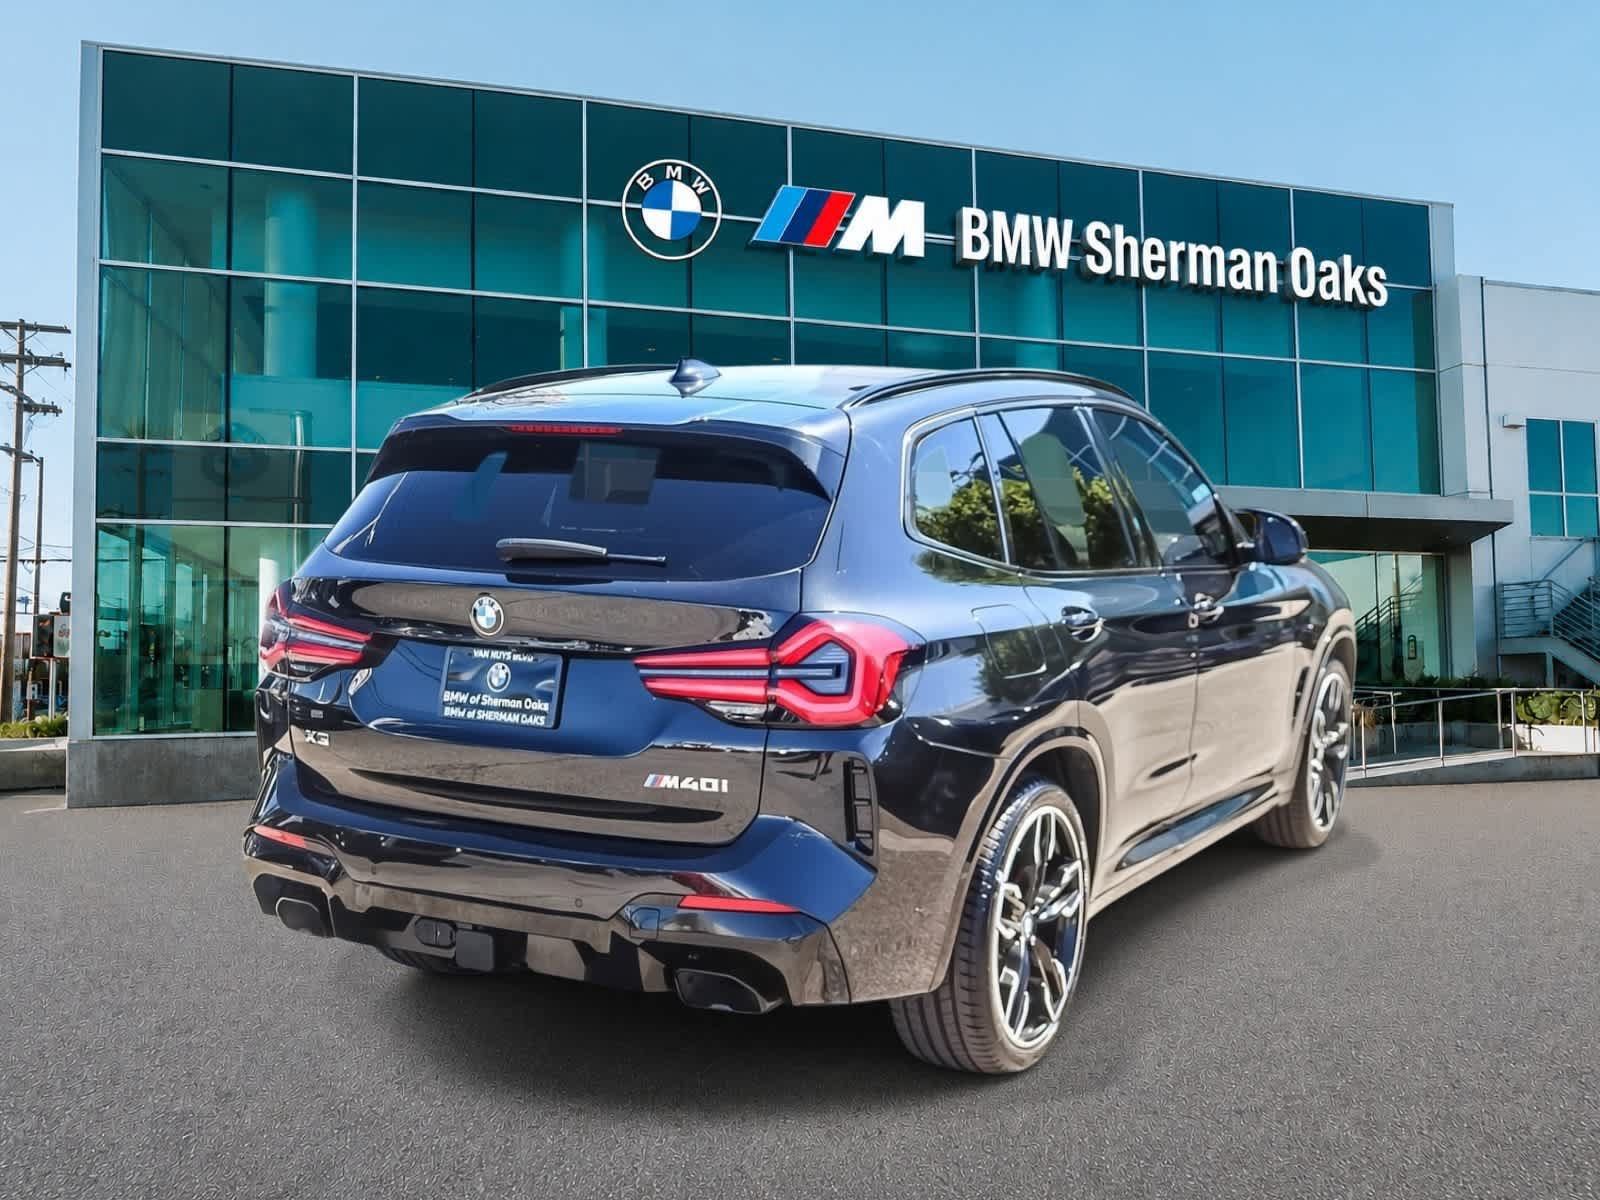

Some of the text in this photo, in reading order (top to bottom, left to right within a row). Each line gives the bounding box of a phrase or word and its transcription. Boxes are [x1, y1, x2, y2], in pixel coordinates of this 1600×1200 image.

[636, 165, 711, 196] BMW
[835, 195, 925, 258] M
[961, 206, 1389, 308] BMW Sherman Oaks
[473, 649, 490, 659] VAN
[490, 650, 512, 661] NUYS
[443, 690, 549, 711] BMW of Sherman Oaks
[444, 707, 546, 726] BMW of SHERMAN OAKS
